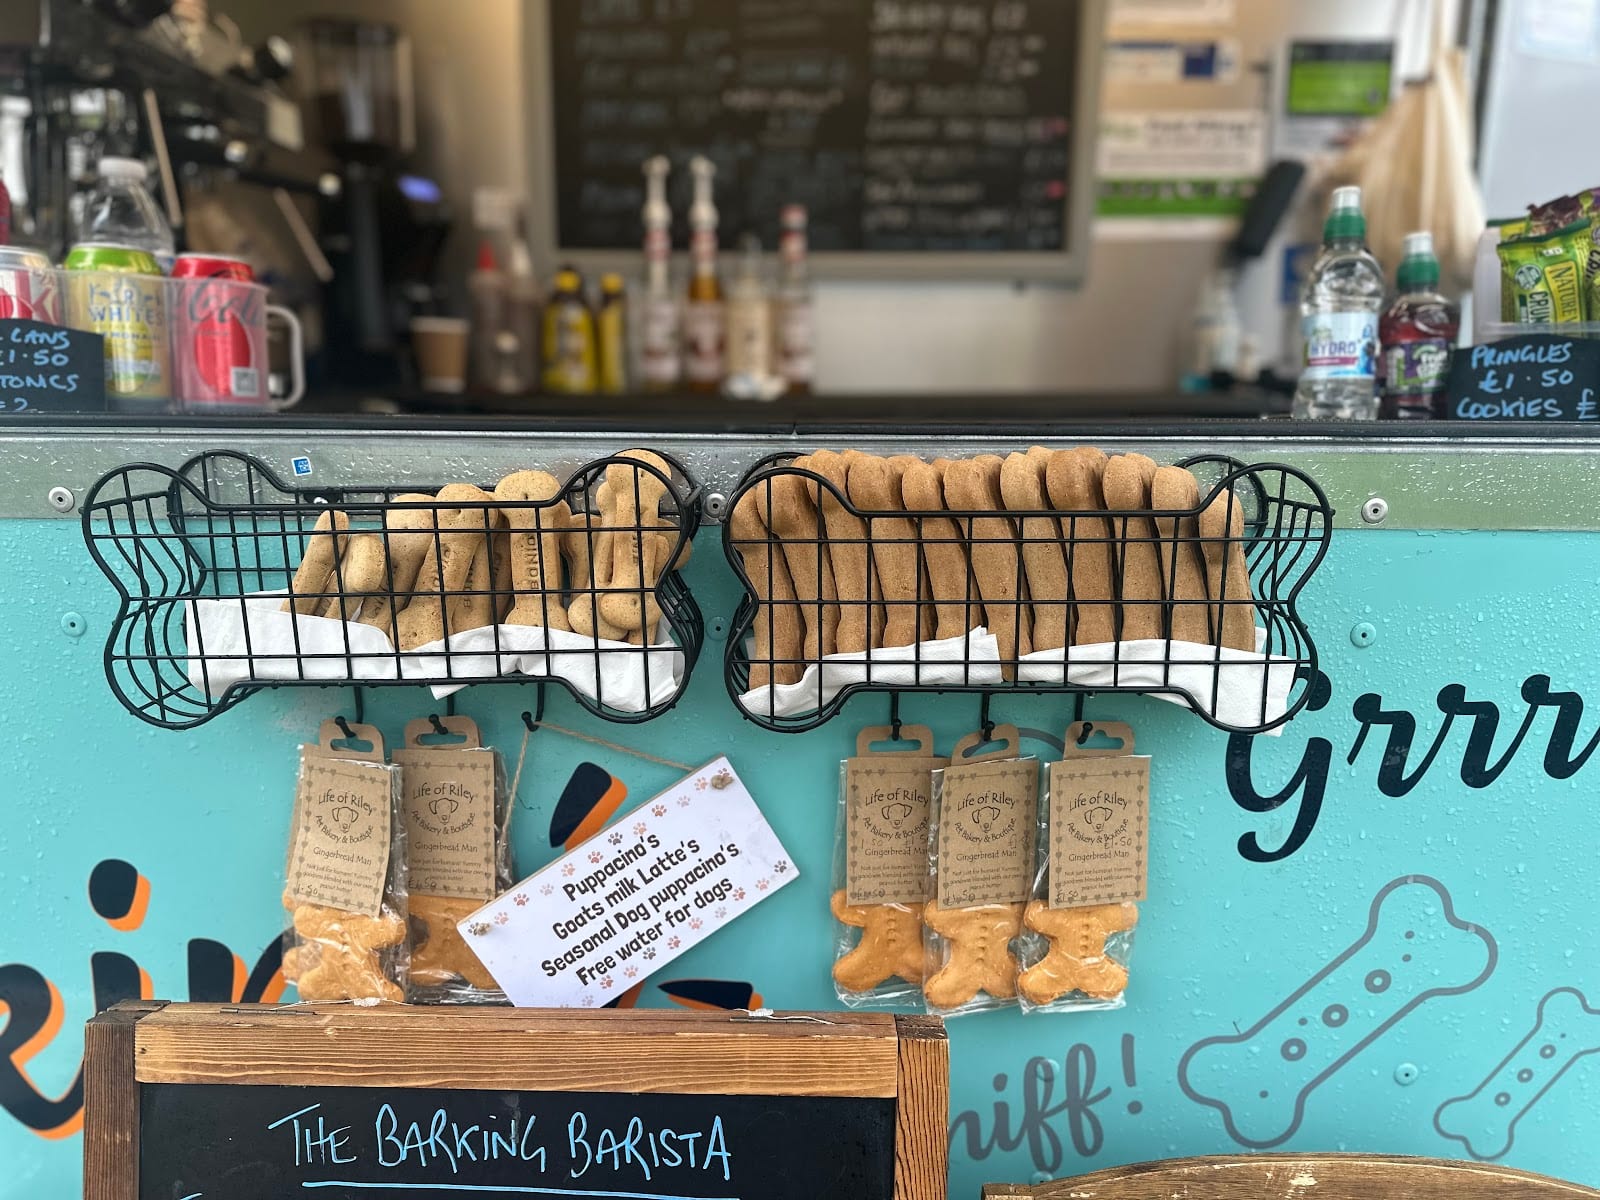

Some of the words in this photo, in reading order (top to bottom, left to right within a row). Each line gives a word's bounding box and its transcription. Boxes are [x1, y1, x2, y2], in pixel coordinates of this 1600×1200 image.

[10, 327, 70, 350] CANS
[1471, 342, 1573, 370] PRINGLES
[319, 789, 335, 804] Life
[338, 793, 348, 803] of
[351, 794, 373, 816] Riley
[413, 782, 430, 799] Life
[434, 783, 446, 794] of
[450, 784, 474, 804] Riley
[866, 789, 883, 806] Life
[887, 788, 901, 800] of
[903, 789, 928, 807] Riley
[958, 793, 974, 811] Life
[978, 791, 990, 804] of
[992, 792, 1015, 809] Riley
[1070, 793, 1086, 811] Life
[1089, 791, 1102, 804] of
[1104, 792, 1127, 810] Riley
[321, 826, 341, 843] Bakery
[350, 825, 373, 843] Boutique
[412, 810, 420, 822] Pet
[420, 820, 441, 835] Bakery
[451, 813, 475, 833] Boutique
[863, 817, 871, 829] Pet
[871, 826, 893, 840] Bakery
[962, 831, 981, 846] Bakery
[992, 818, 1016, 840] Boutique
[1067, 823, 1075, 834] Pet
[1074, 831, 1095, 845] Bakery
[1104, 819, 1128, 841] Boutique
[313, 847, 354, 862] Gingerbread
[357, 856, 371, 865] Man
[415, 842, 459, 852] Gingerbread
[462, 844, 478, 852] Man
[865, 847, 910, 857] Gingerbread
[956, 850, 999, 862] Gingerbread
[1069, 852, 1111, 863] Gingerbread
[562, 834, 660, 902] Puppacino's
[552, 901, 605, 940] Goats
[604, 876, 641, 908] milk
[636, 839, 701, 885] Latte's
[541, 919, 618, 977] Seasonal
[613, 902, 651, 930] Dog
[648, 842, 740, 914] puppacino's
[575, 954, 617, 986] Free
[615, 921, 665, 962] water
[664, 902, 693, 928] for
[693, 877, 734, 910] dogs
[268, 1103, 357, 1167] THE
[373, 1103, 546, 1174] BARKING
[567, 1109, 732, 1182] BARISTA
